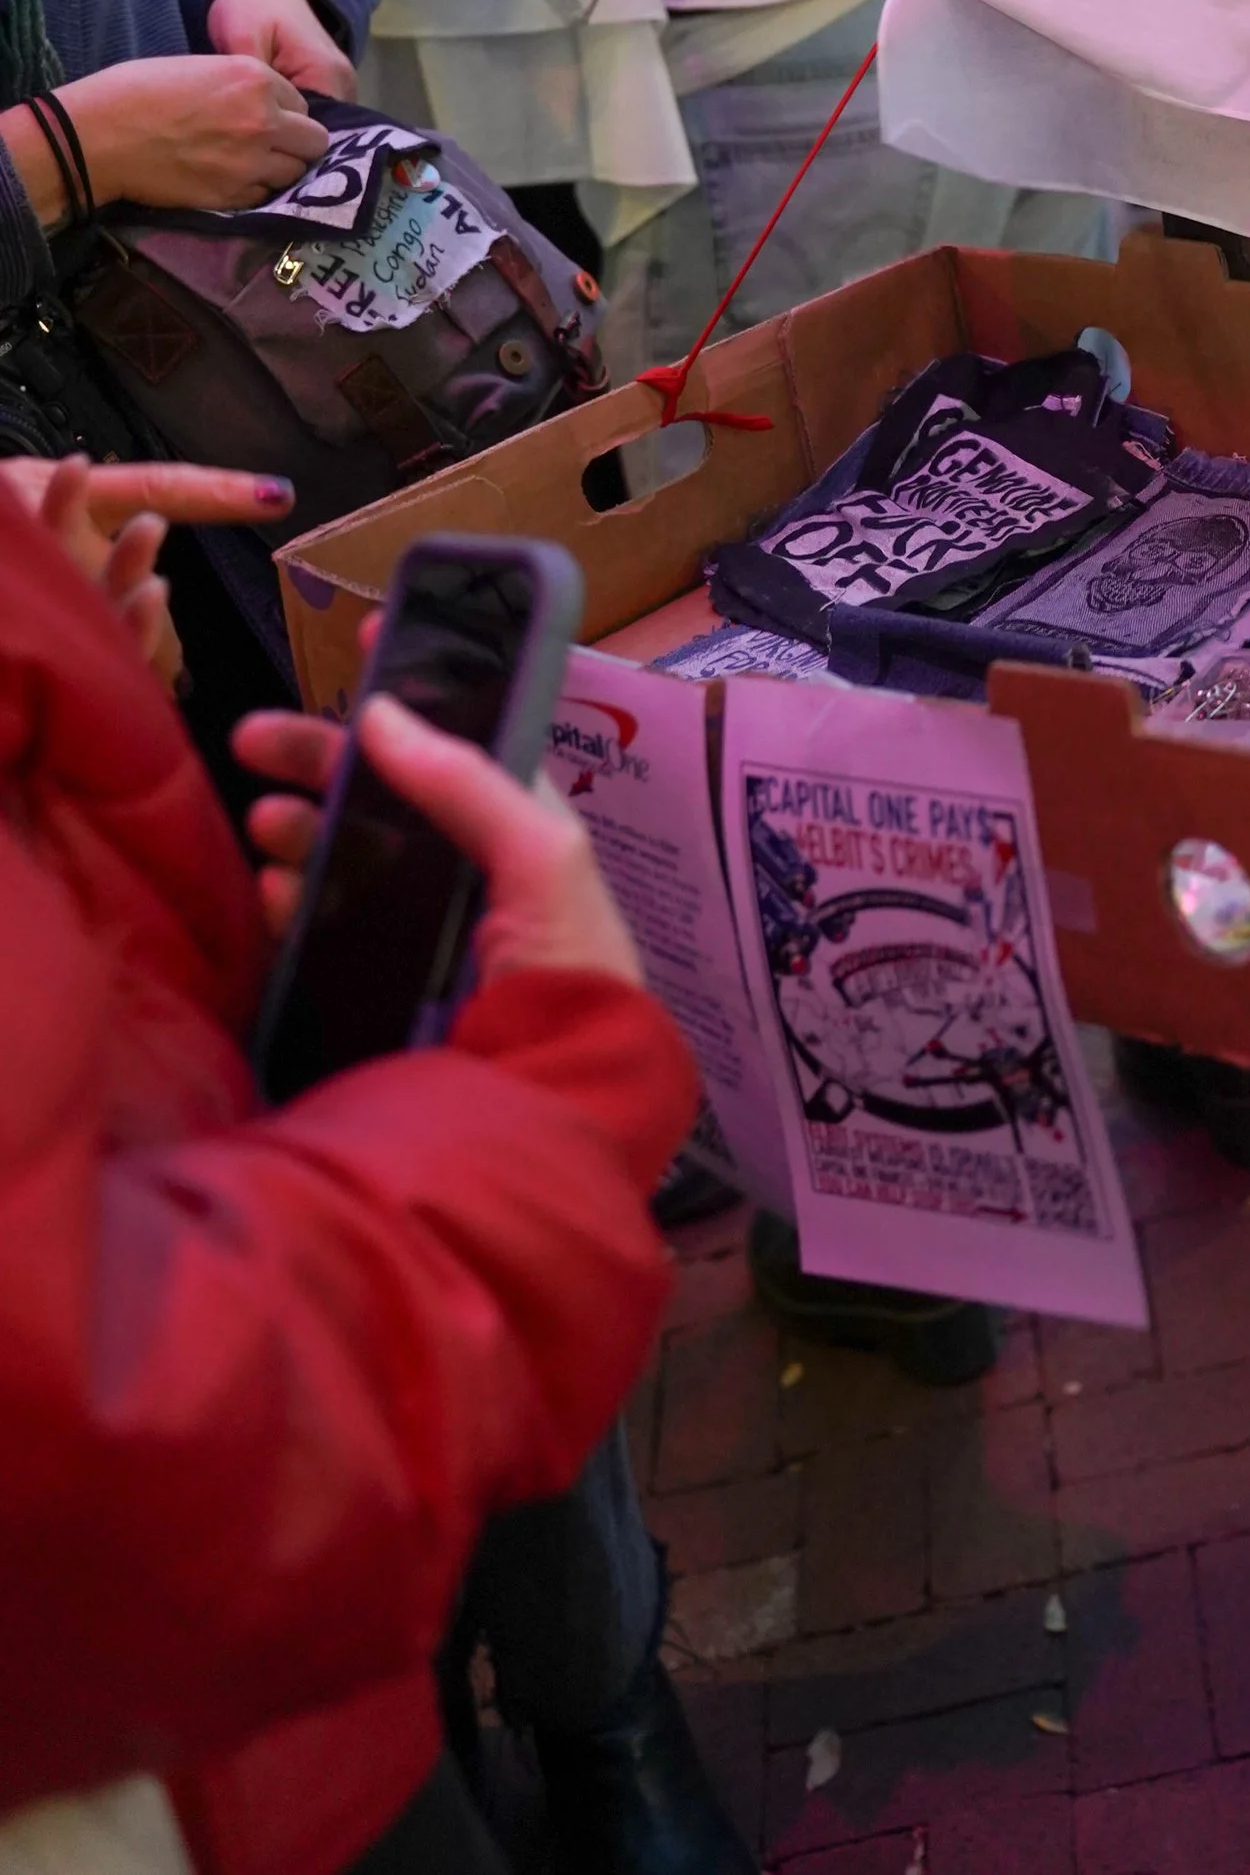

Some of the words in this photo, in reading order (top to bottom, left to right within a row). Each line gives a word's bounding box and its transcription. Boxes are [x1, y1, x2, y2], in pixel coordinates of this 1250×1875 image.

[373, 218, 425, 283] Congo
[396, 243, 446, 305] Sudan
[928, 437, 1078, 523] GENOCIDE
[771, 520, 919, 596] OFF
[836, 495, 986, 572] FUCK
[764, 776, 861, 825] CAPITAL
[868, 791, 918, 833] ONE
